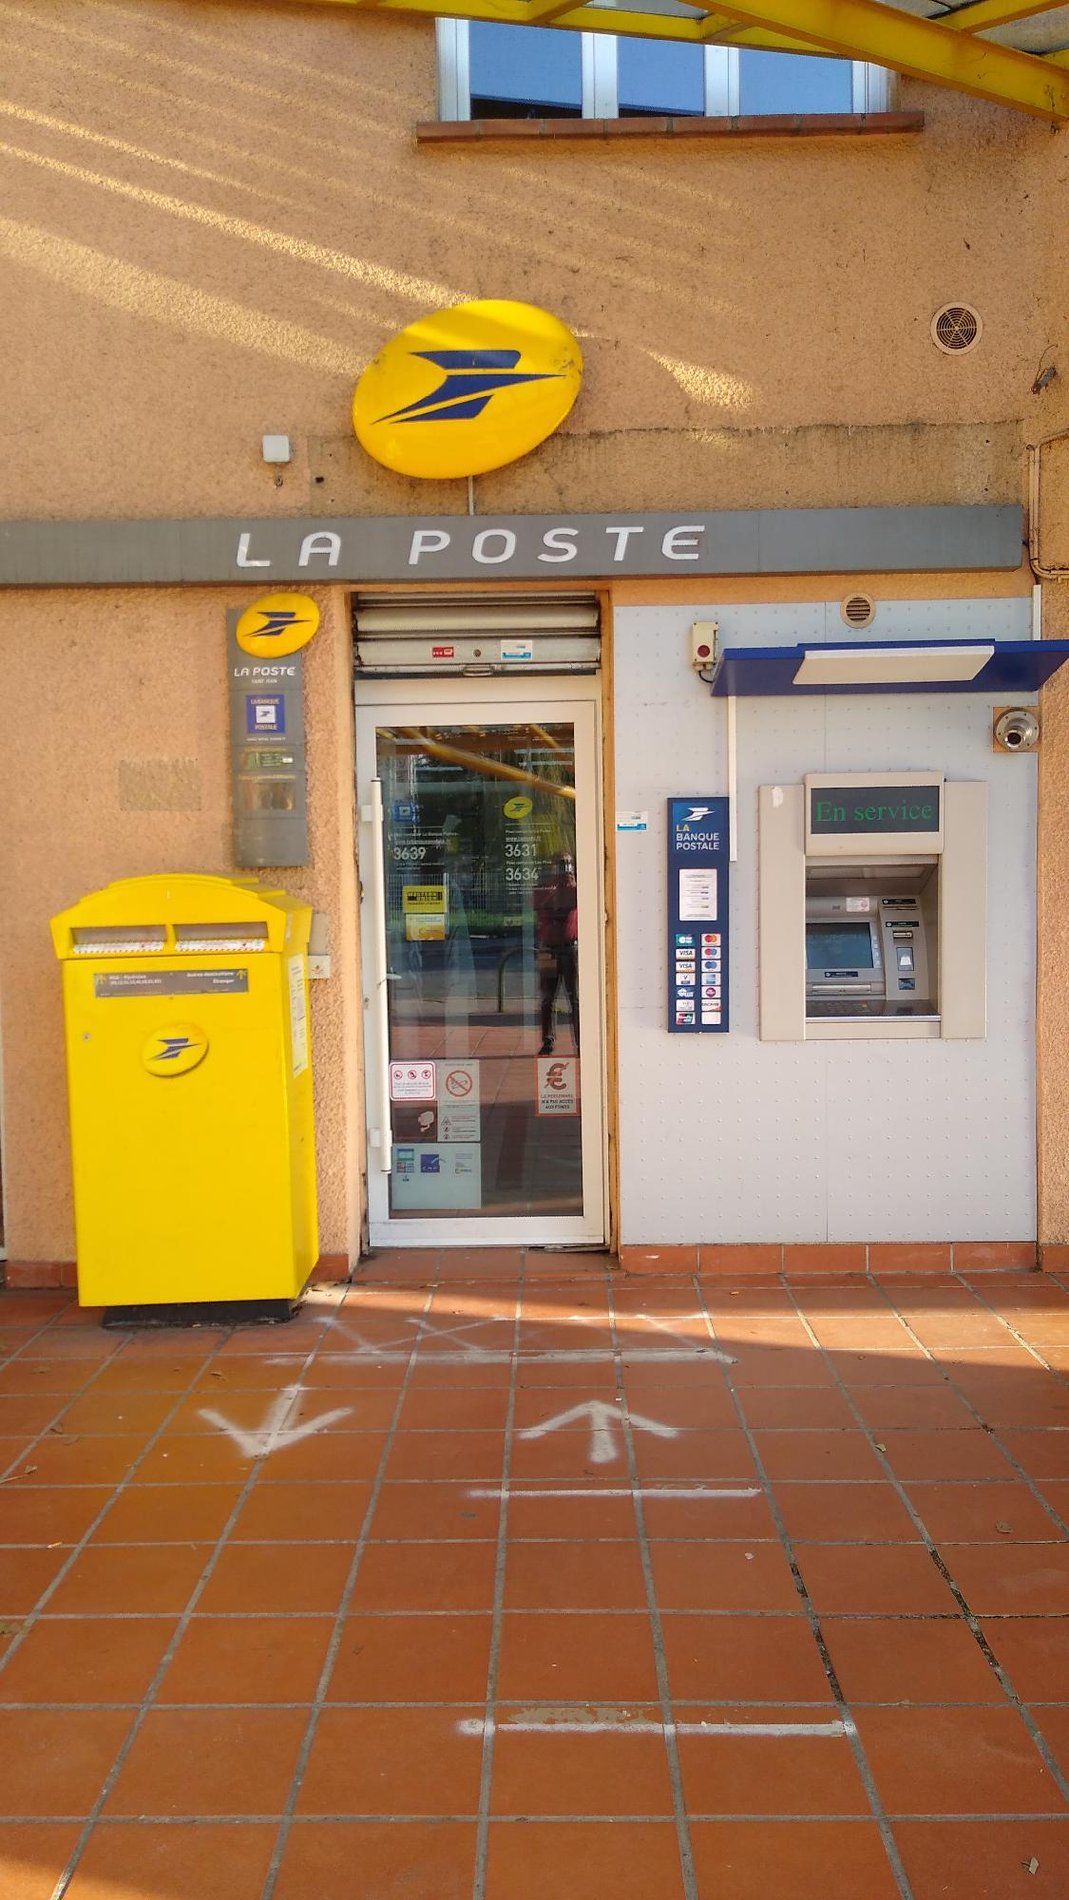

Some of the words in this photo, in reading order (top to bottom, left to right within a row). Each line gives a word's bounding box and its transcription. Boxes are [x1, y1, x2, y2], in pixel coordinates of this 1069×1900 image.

[236, 531, 341, 568] LA
[408, 524, 705, 567] POSTE
[234, 667, 249, 677] LA
[252, 666, 296, 676] POSTE
[815, 801, 847, 822] En
[854, 800, 933, 821] service
[676, 824, 690, 832] LA
[676, 832, 720, 841] BANQUE
[505, 844, 536, 857] 3631
[676, 841, 720, 851] POSTALE
[393, 846, 426, 860] 3639
[505, 868, 539, 881] 3634
